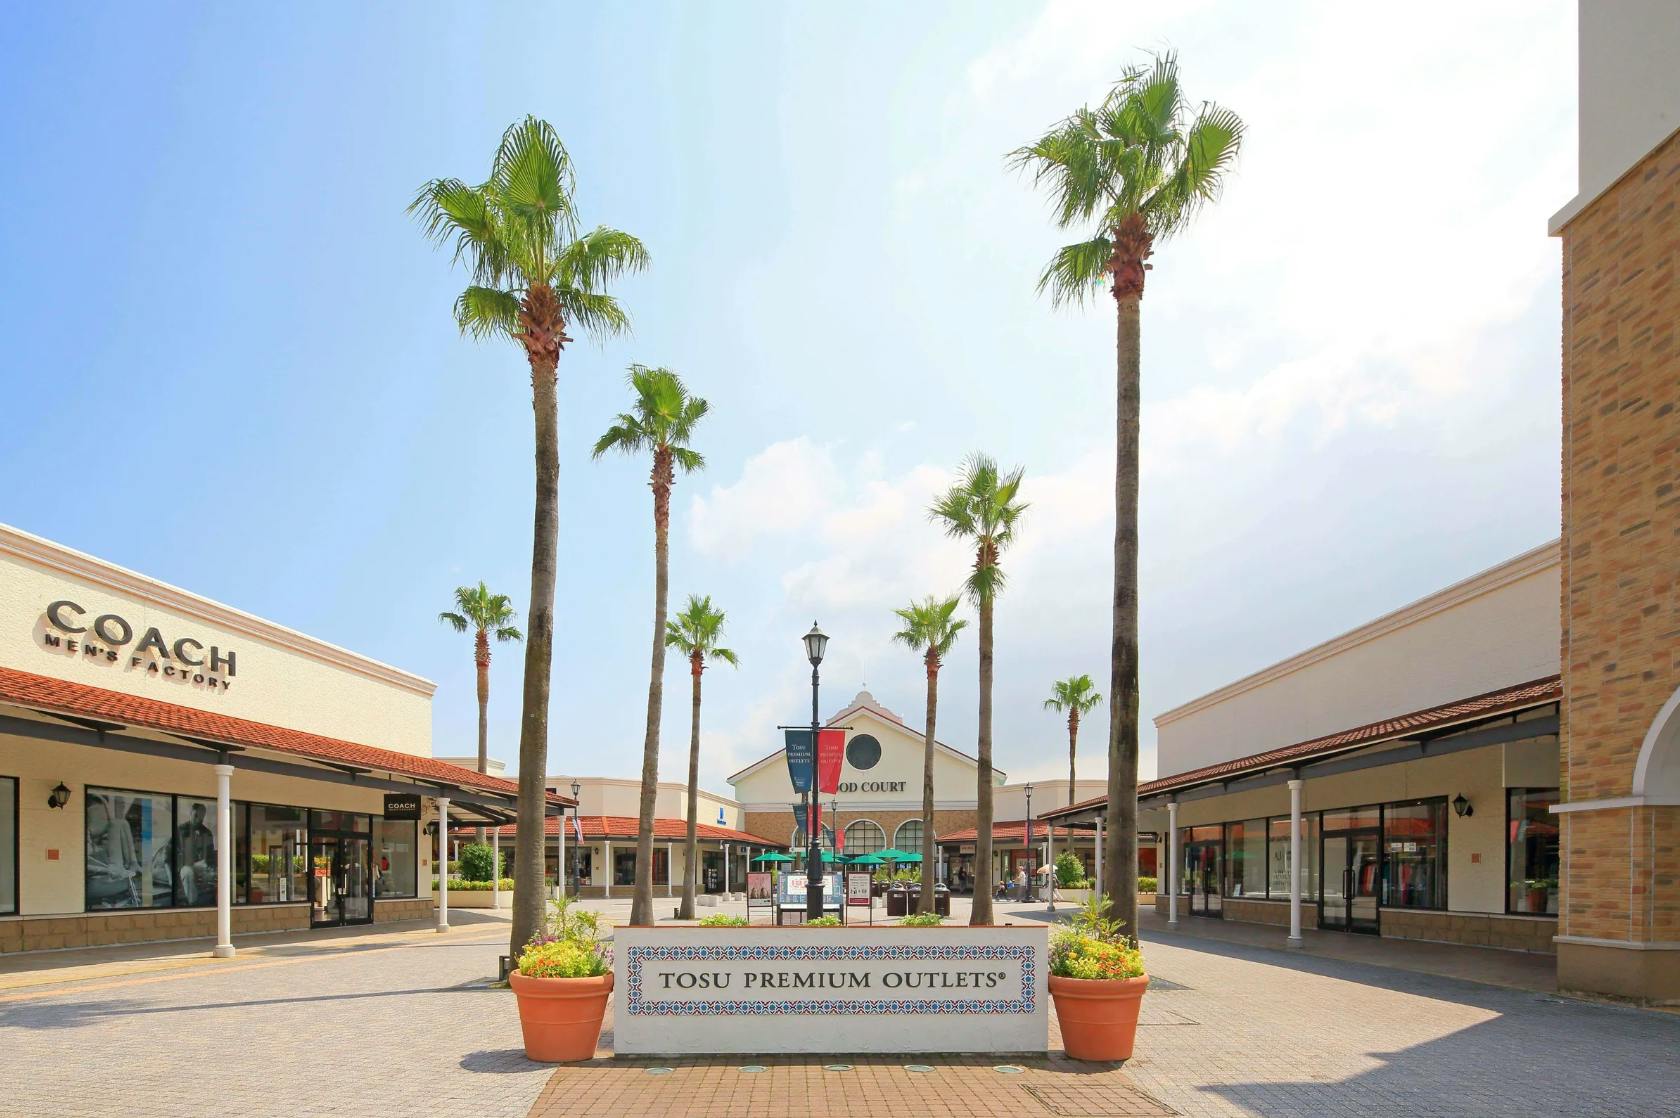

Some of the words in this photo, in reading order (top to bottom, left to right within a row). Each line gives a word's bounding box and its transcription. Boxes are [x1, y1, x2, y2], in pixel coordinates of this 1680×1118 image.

[46, 600, 237, 677] COACH
[45, 633, 118, 662] MEN'S
[131, 656, 232, 690] FACTORY
[837, 782, 858, 793] OD
[861, 781, 907, 792] COURT
[658, 972, 731, 989] TOSU
[743, 972, 872, 989] PREMIUM
